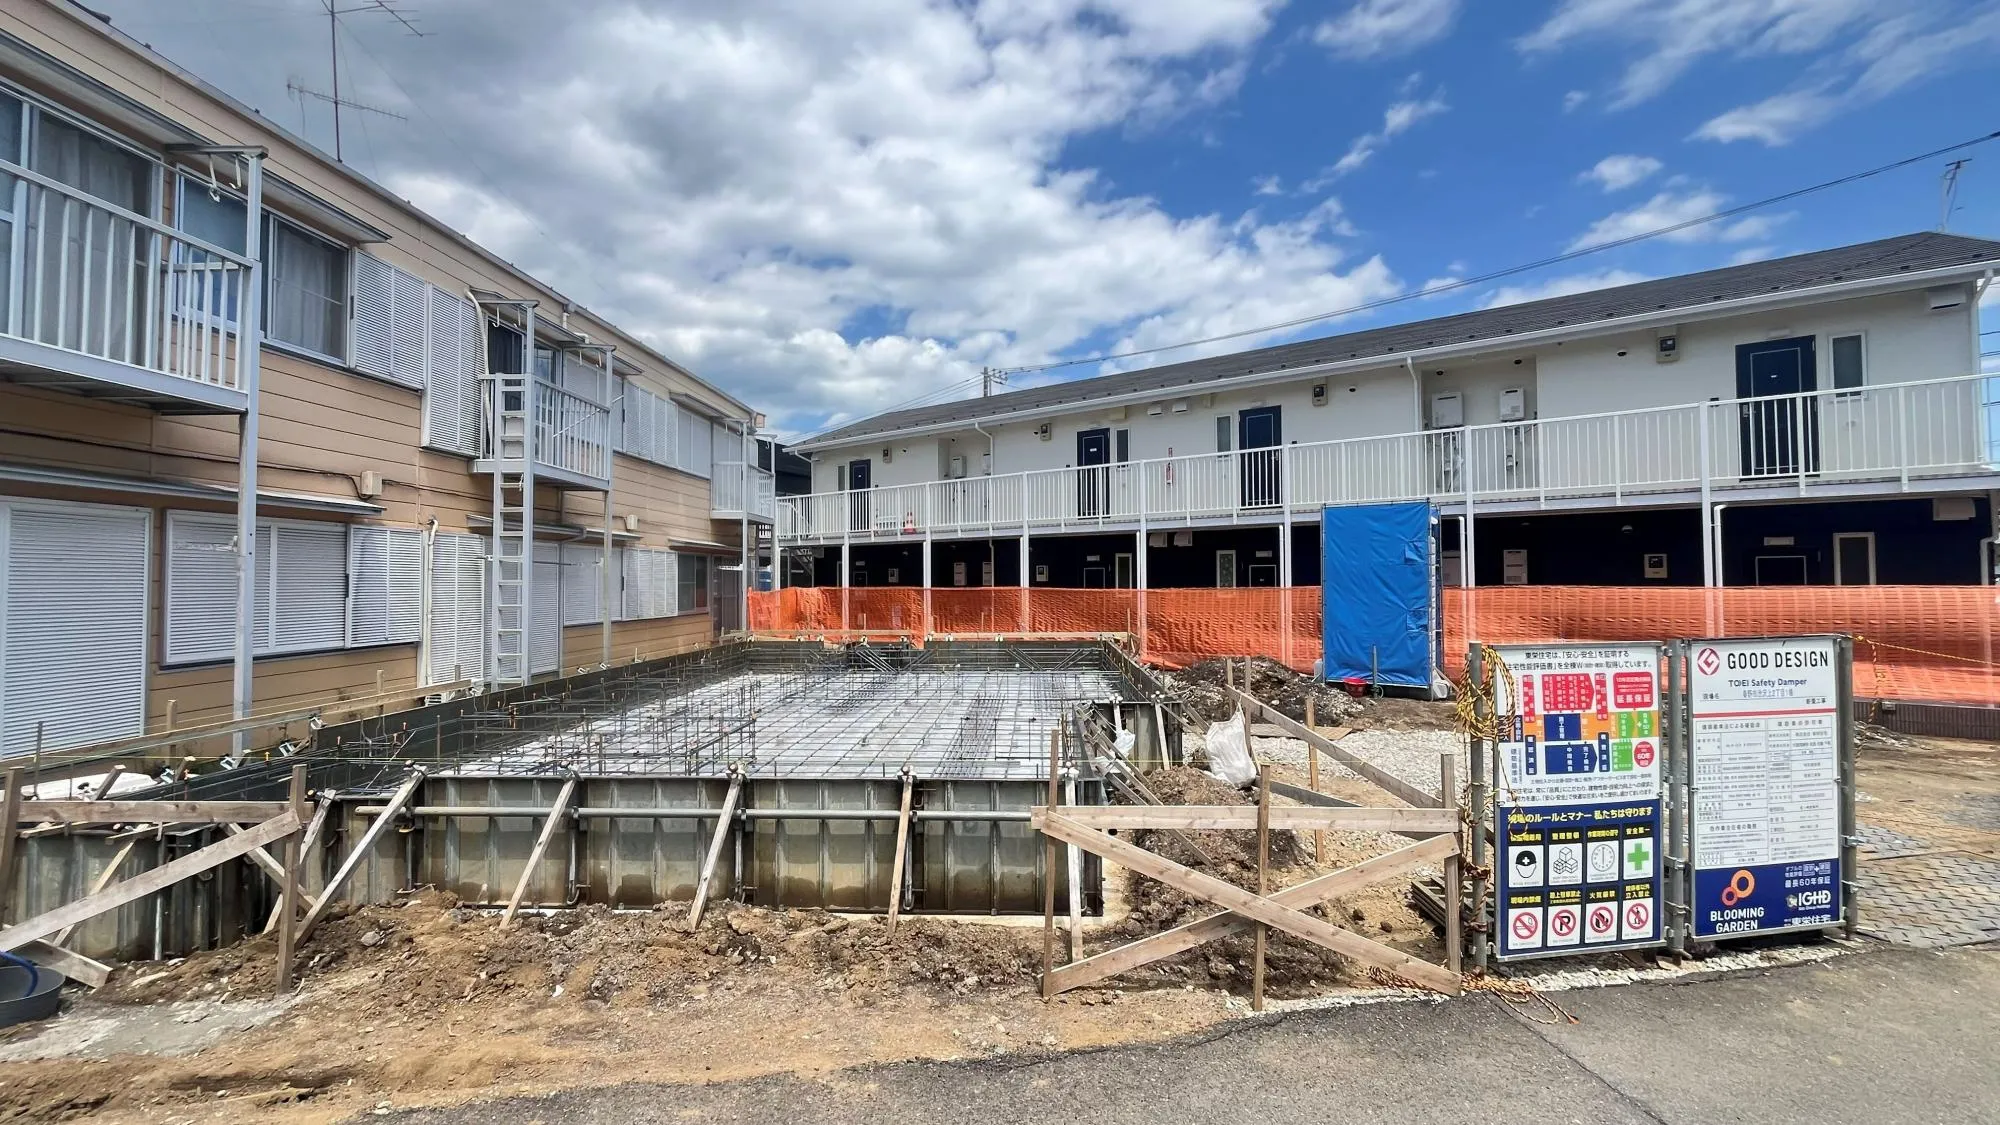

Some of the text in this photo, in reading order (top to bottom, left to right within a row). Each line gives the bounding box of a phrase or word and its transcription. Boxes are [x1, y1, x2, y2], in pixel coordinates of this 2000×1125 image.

[1727, 651, 1828, 670] GOOD DESIGN
[1751, 679, 1775, 688] Safety
[1778, 678, 1807, 687] Damper
[1508, 807, 1653, 824] 現場のルールとマナー 私たちは守ります
[1626, 827, 1650, 835] 安全第一
[1785, 877, 1830, 888] 最長60年保証
[1799, 890, 1831, 906] IGHD
[1710, 907, 1764, 921] BLOOMING
[1716, 920, 1758, 933] GARDEN
